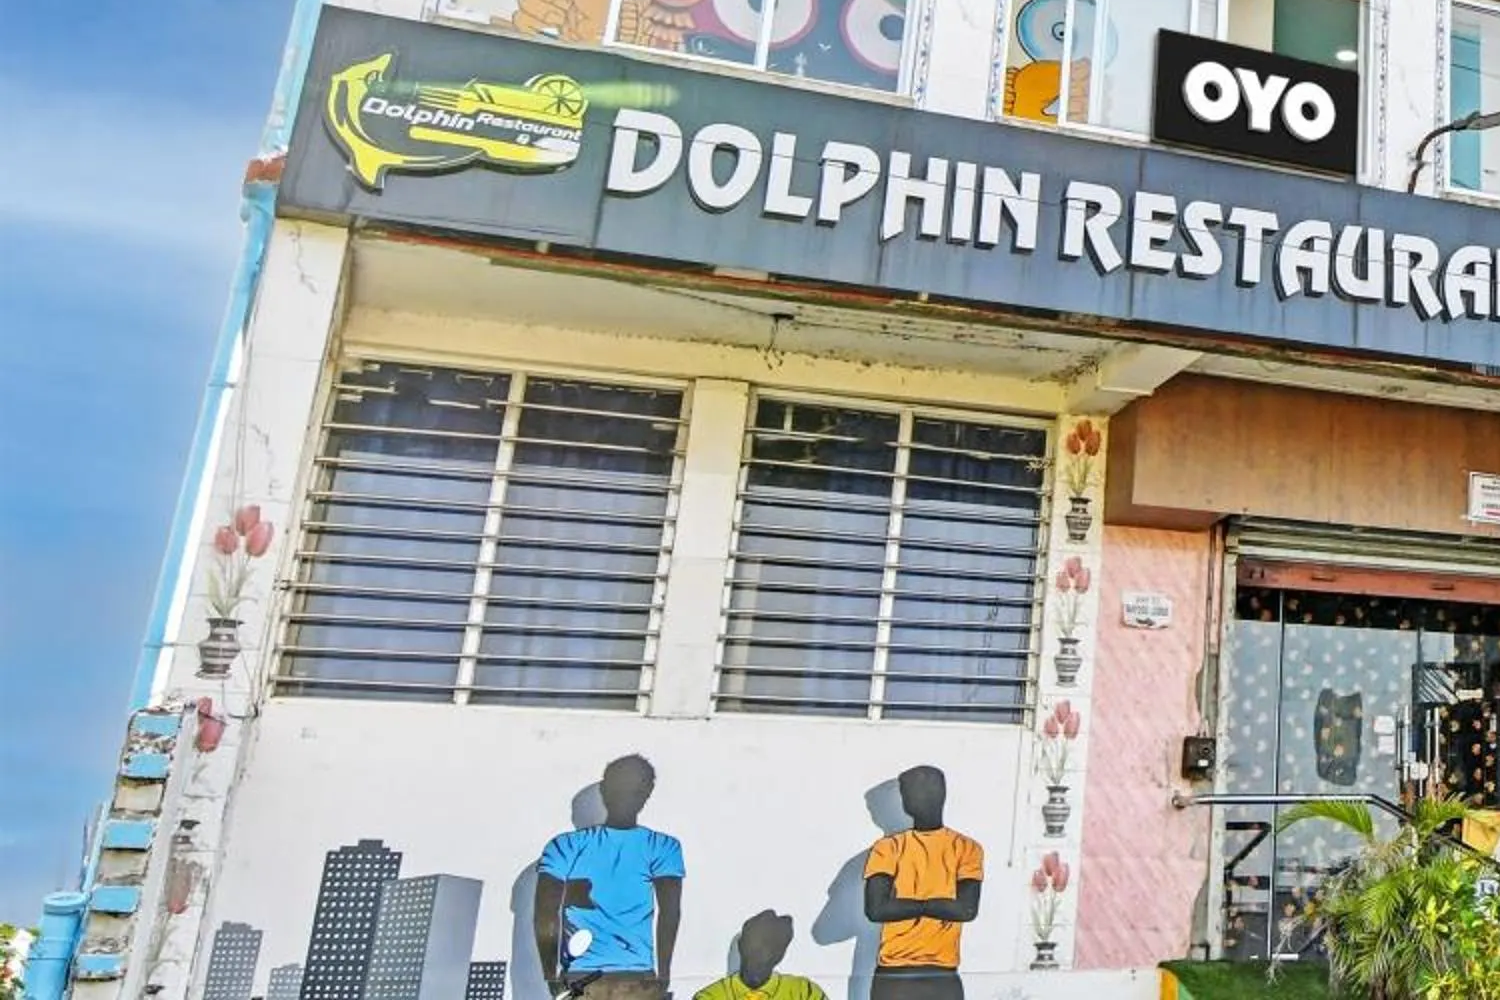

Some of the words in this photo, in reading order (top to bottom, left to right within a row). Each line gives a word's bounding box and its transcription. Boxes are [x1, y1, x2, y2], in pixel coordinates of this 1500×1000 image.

[362, 96, 475, 131] Dolphin
[475, 111, 583, 141] Restaurant
[1182, 60, 1336, 142] OYO
[605, 107, 1042, 251] DOLPHIN
